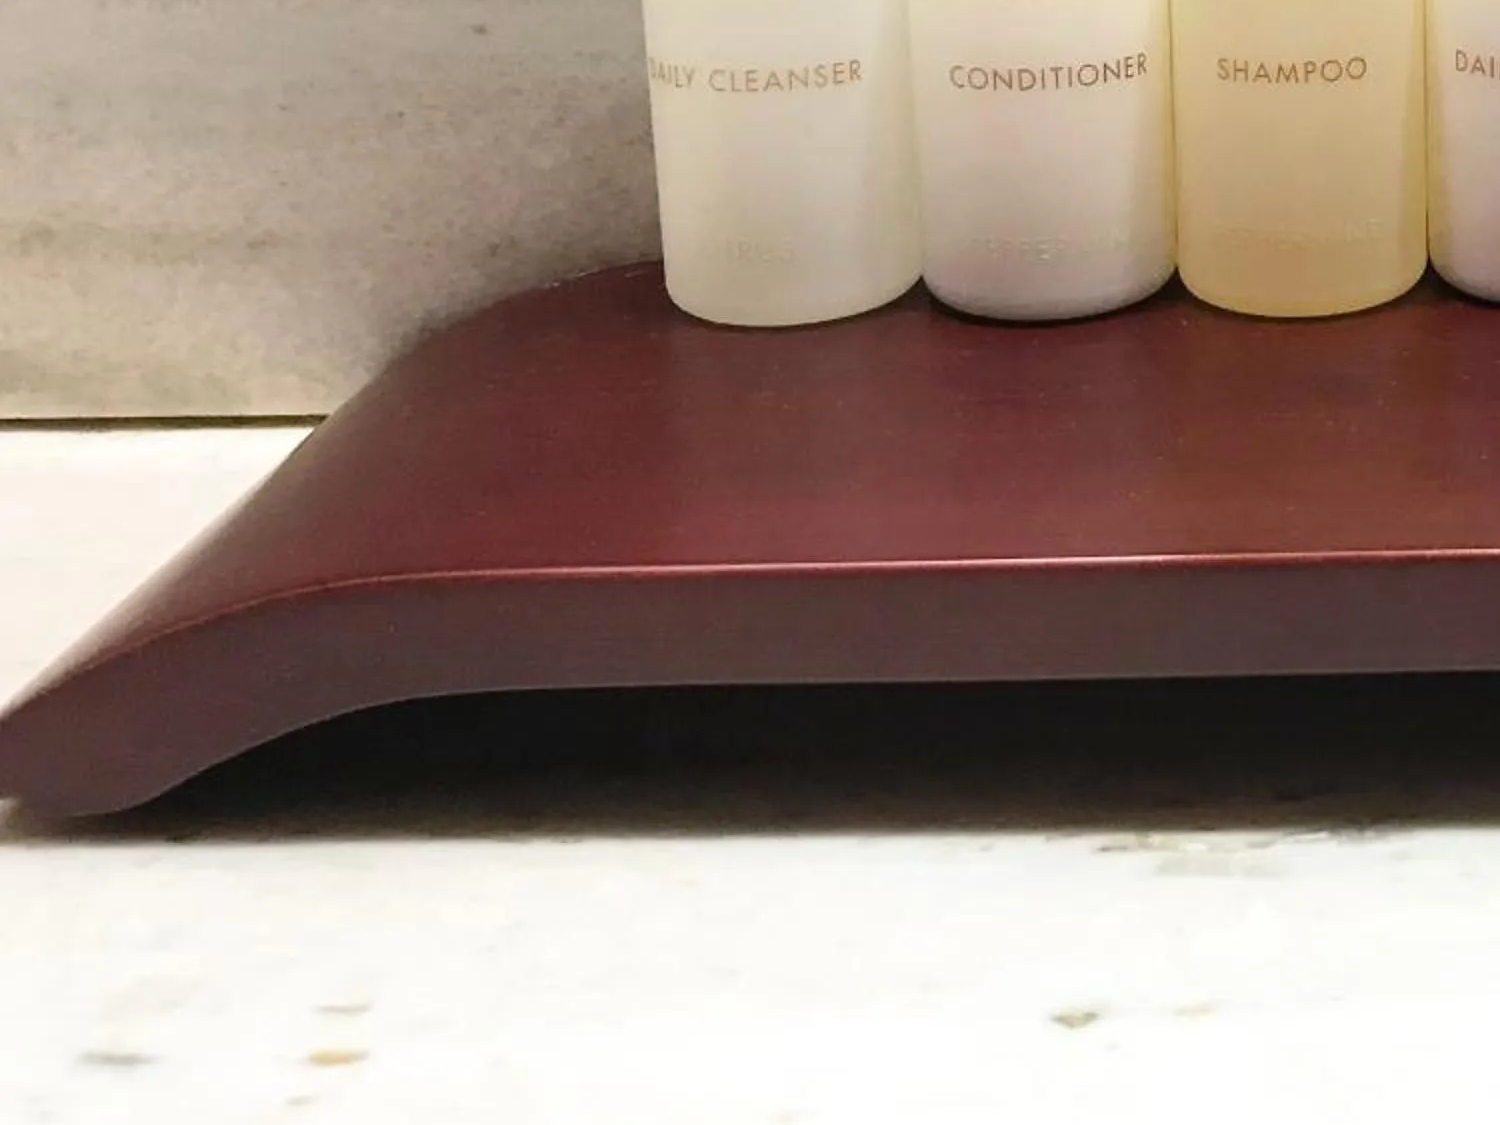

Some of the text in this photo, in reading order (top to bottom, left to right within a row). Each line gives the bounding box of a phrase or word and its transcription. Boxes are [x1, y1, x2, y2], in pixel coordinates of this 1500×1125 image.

[708, 58, 862, 93] CLEANSER
[949, 52, 1148, 92] CONDITIONER
[1216, 56, 1368, 84] SHAMPOO
